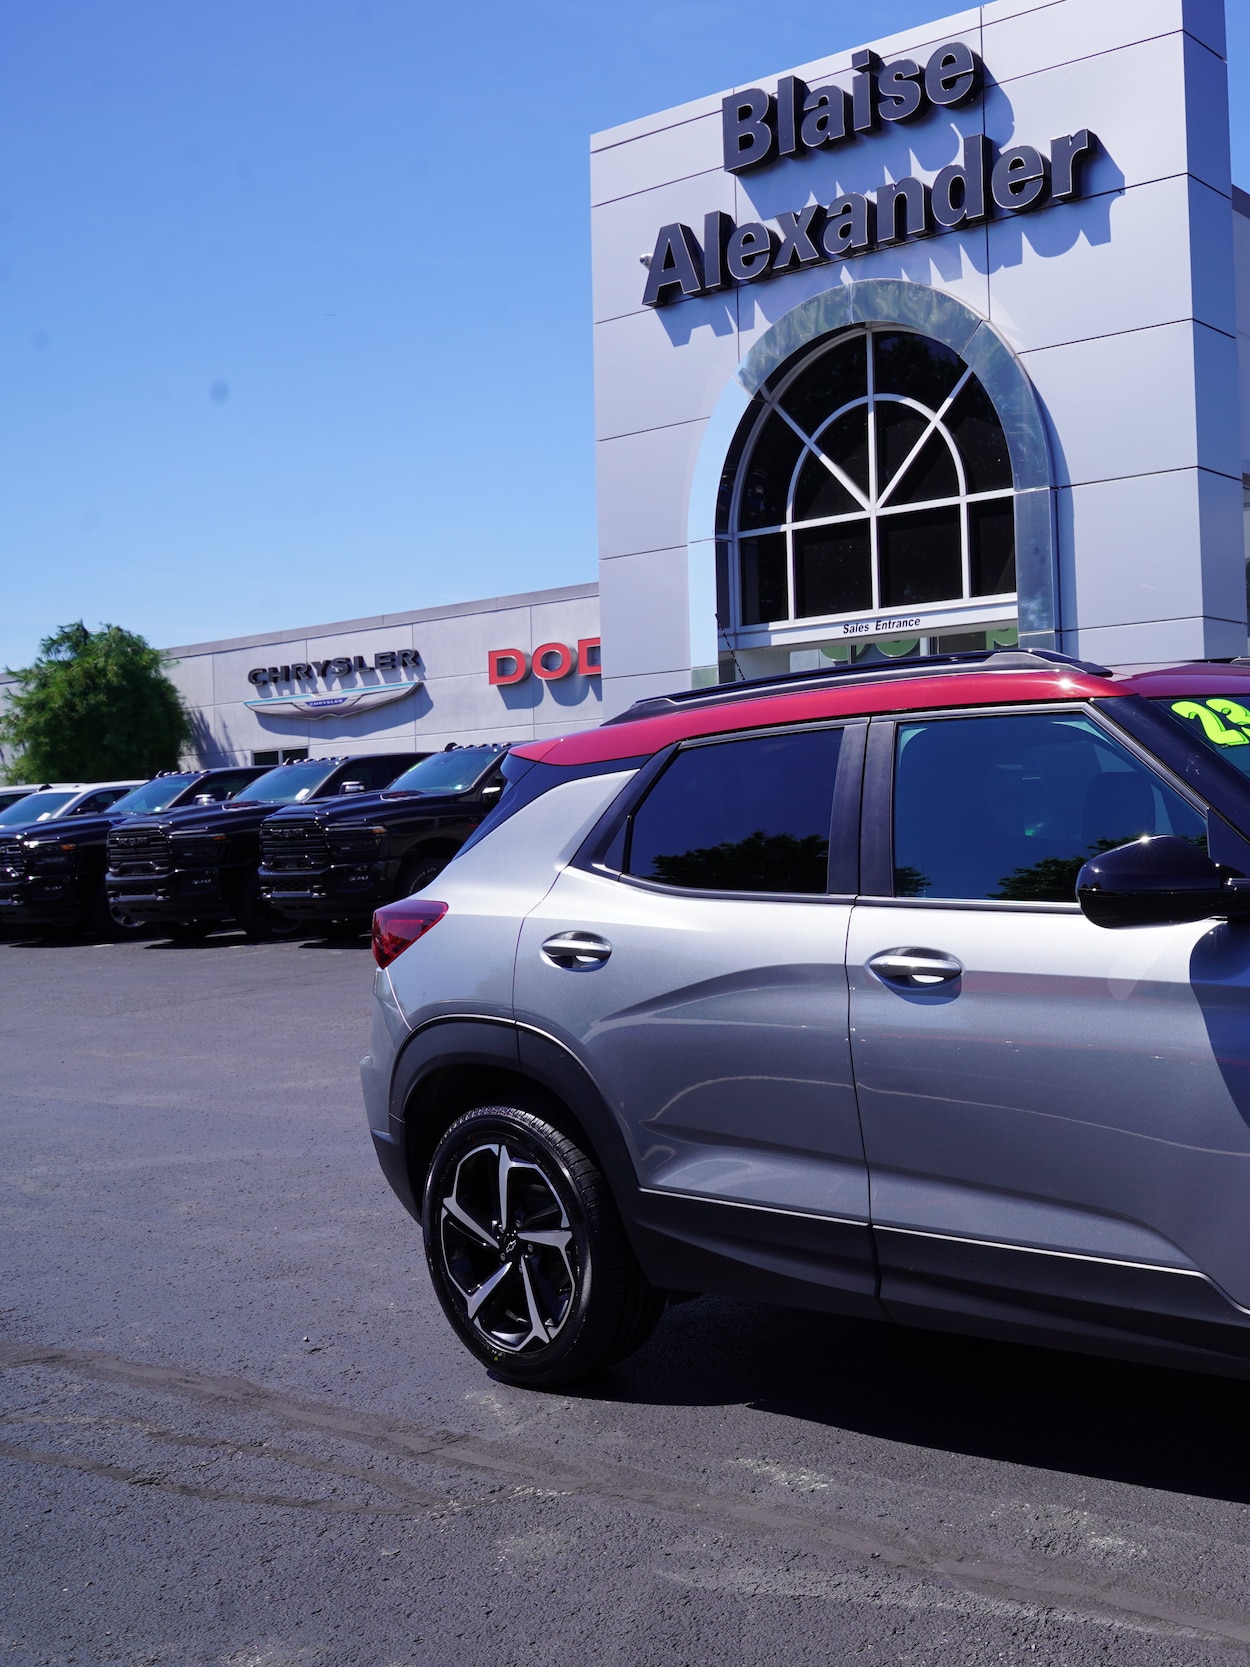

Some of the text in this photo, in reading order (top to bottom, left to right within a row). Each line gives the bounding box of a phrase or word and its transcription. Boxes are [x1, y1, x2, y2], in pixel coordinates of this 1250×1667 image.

[722, 41, 983, 174] Blaise
[642, 128, 1097, 308] Alexander
[248, 649, 420, 687] CHRYSLER
[843, 618, 921, 634] Sales Entrance
